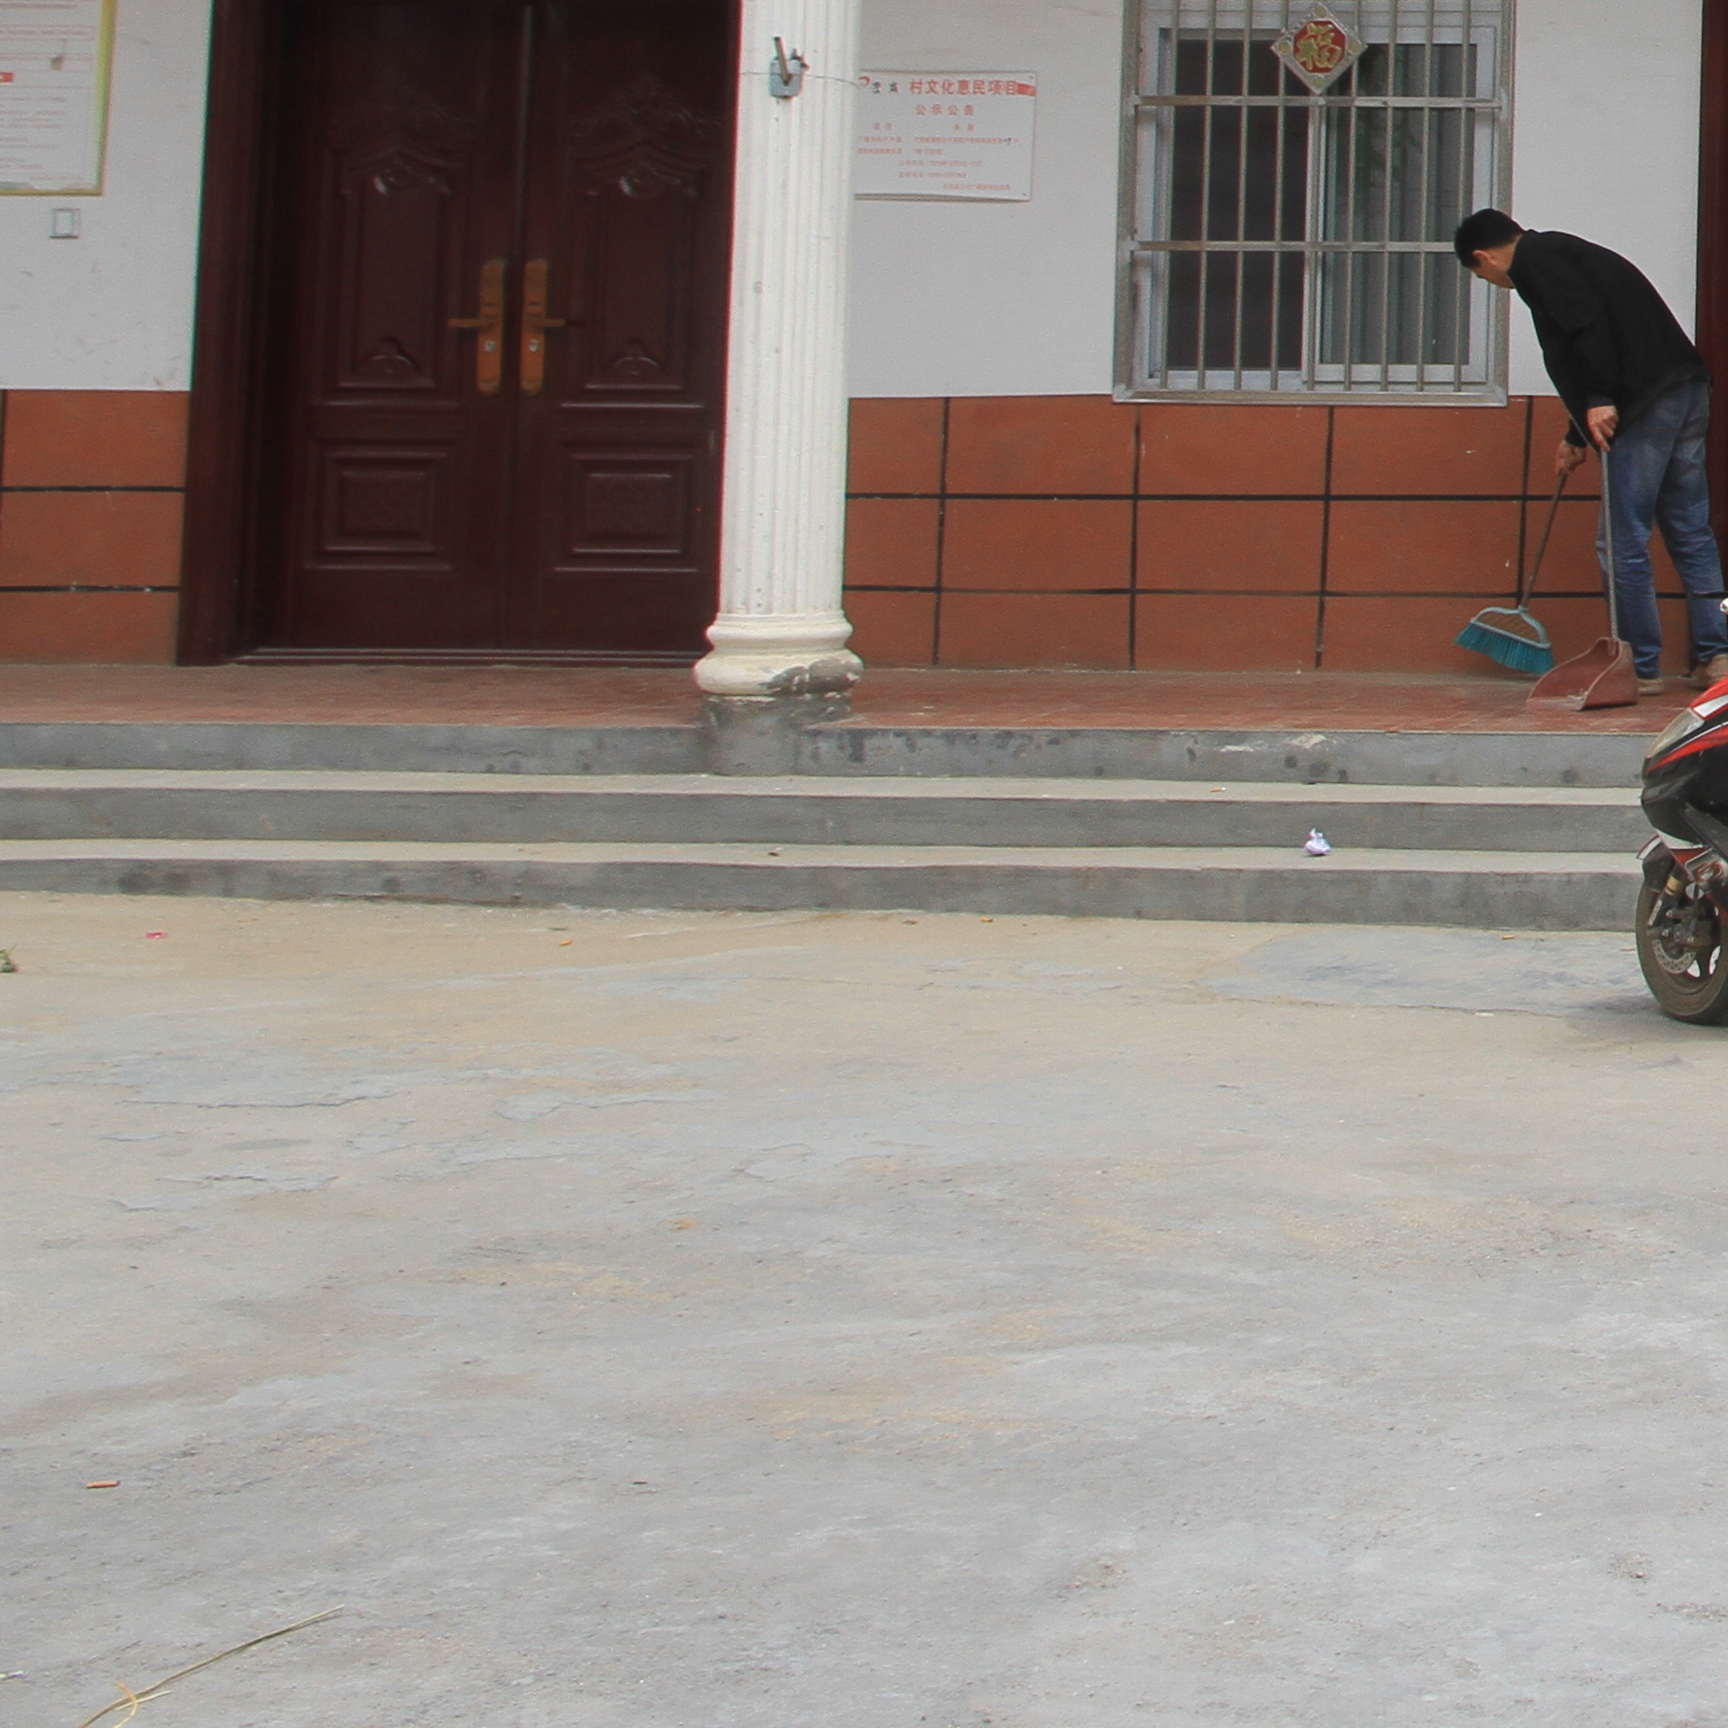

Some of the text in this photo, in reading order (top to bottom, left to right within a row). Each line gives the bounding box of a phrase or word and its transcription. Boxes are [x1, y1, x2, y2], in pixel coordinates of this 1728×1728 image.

[1296, 22, 1342, 70] 福
[909, 79, 1018, 96] 村文化惠民项目
